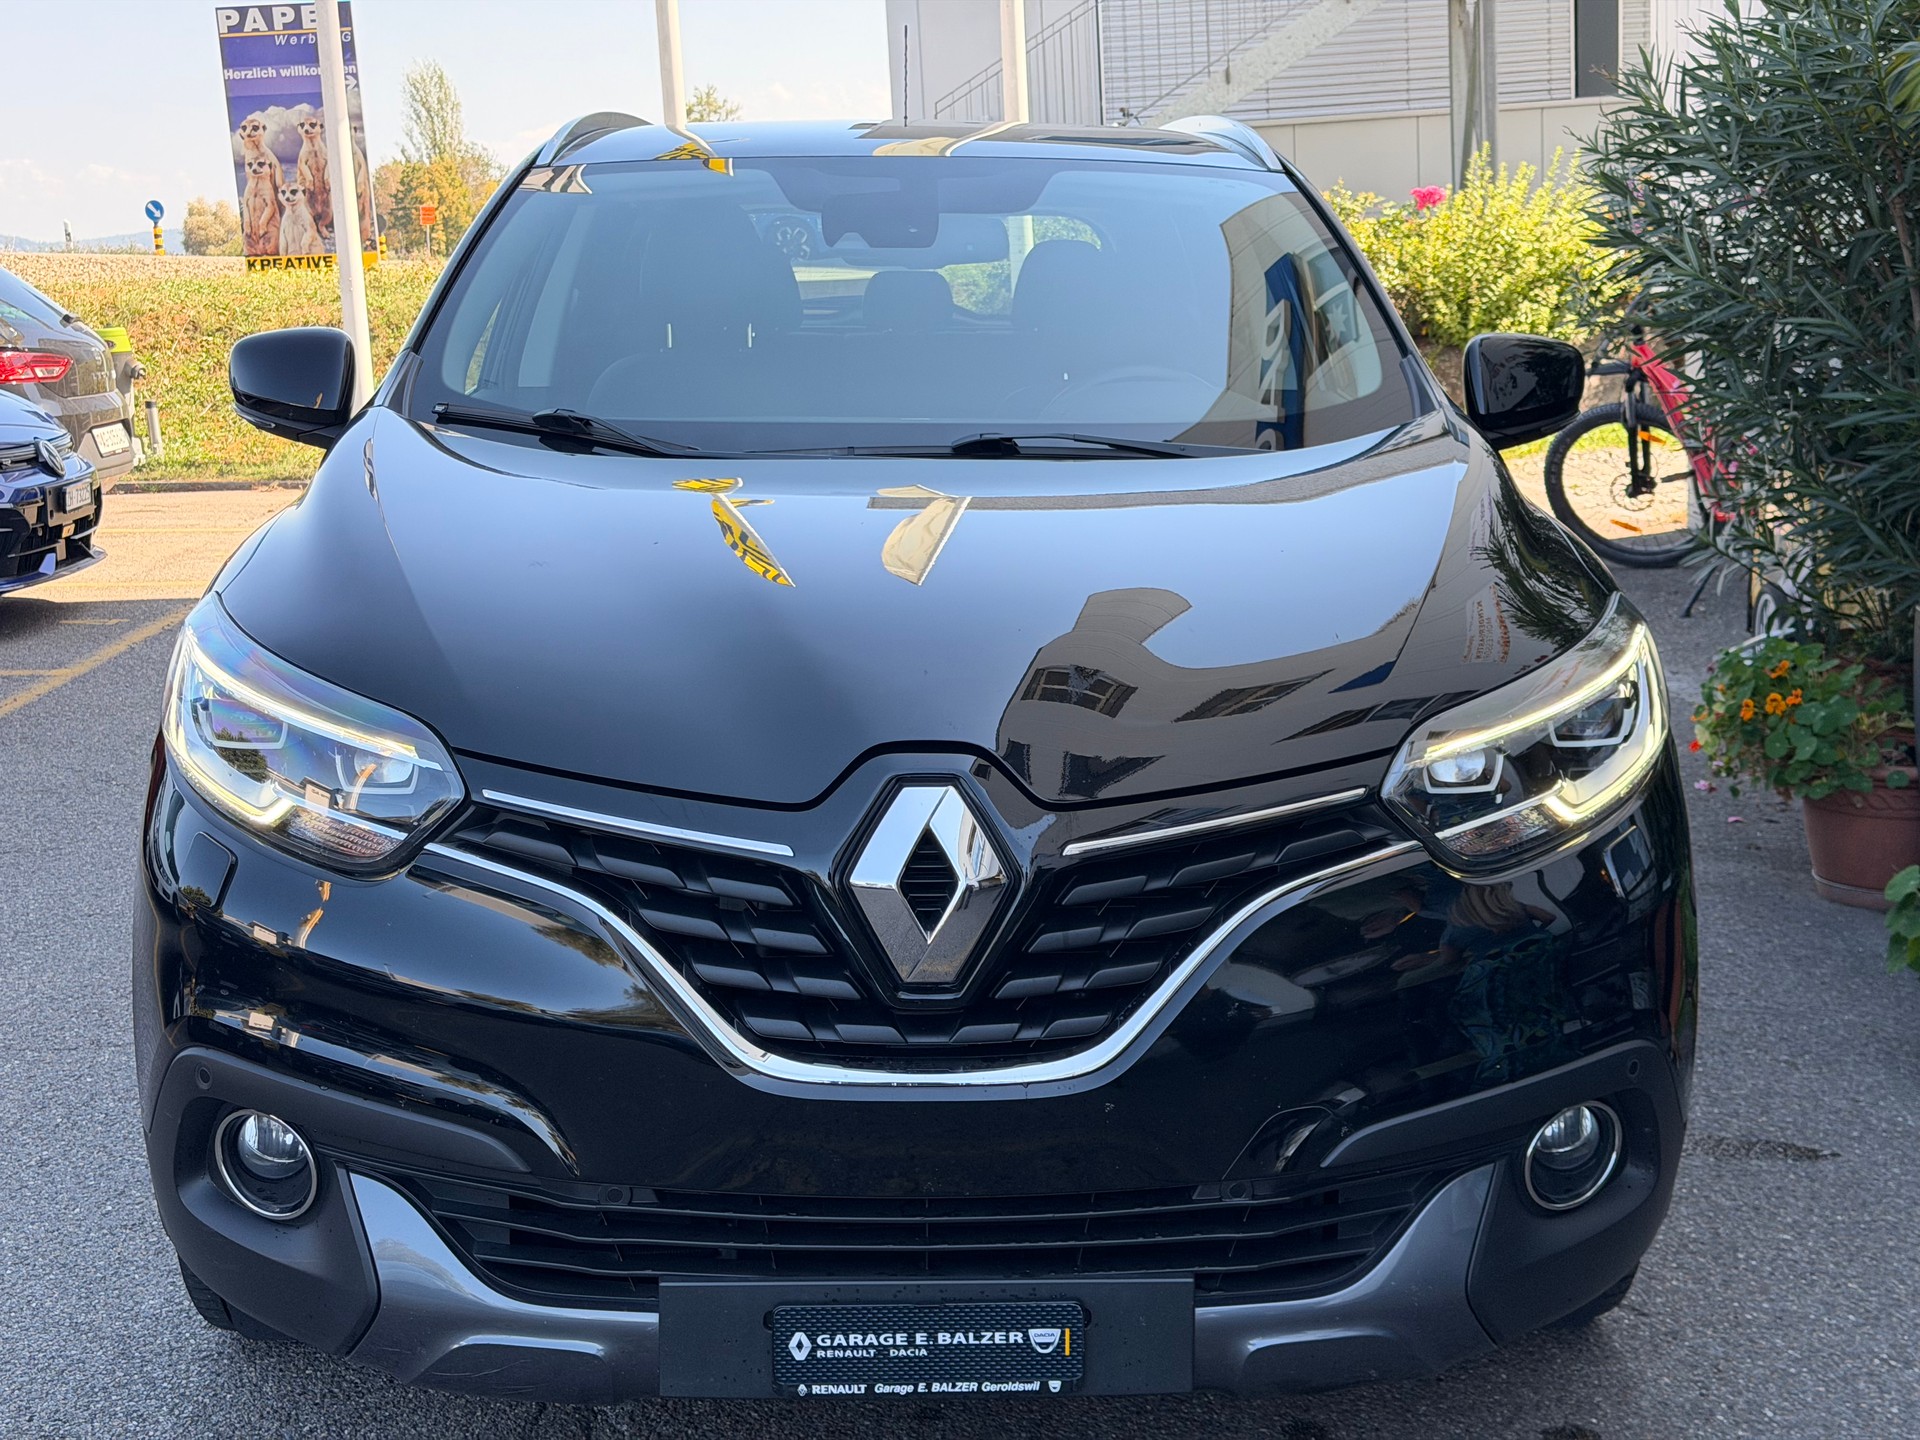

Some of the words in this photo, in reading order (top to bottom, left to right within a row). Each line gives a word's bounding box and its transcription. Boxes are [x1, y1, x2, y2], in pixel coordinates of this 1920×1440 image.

[224, 67, 277, 80] Herzlich
[280, 65, 357, 78] willkoen
[816, 1333, 909, 1347] GARAGE
[915, 1333, 934, 1345] E.
[937, 1331, 1024, 1344] BALZER
[816, 1349, 876, 1358] RENAULT
[889, 1348, 928, 1357] DACIA
[812, 1383, 867, 1394] RENAULT
[874, 1383, 914, 1395] Garage
[917, 1383, 929, 1393] E.
[931, 1382, 978, 1393] BALZER
[981, 1380, 1040, 1392] Geroldswil
